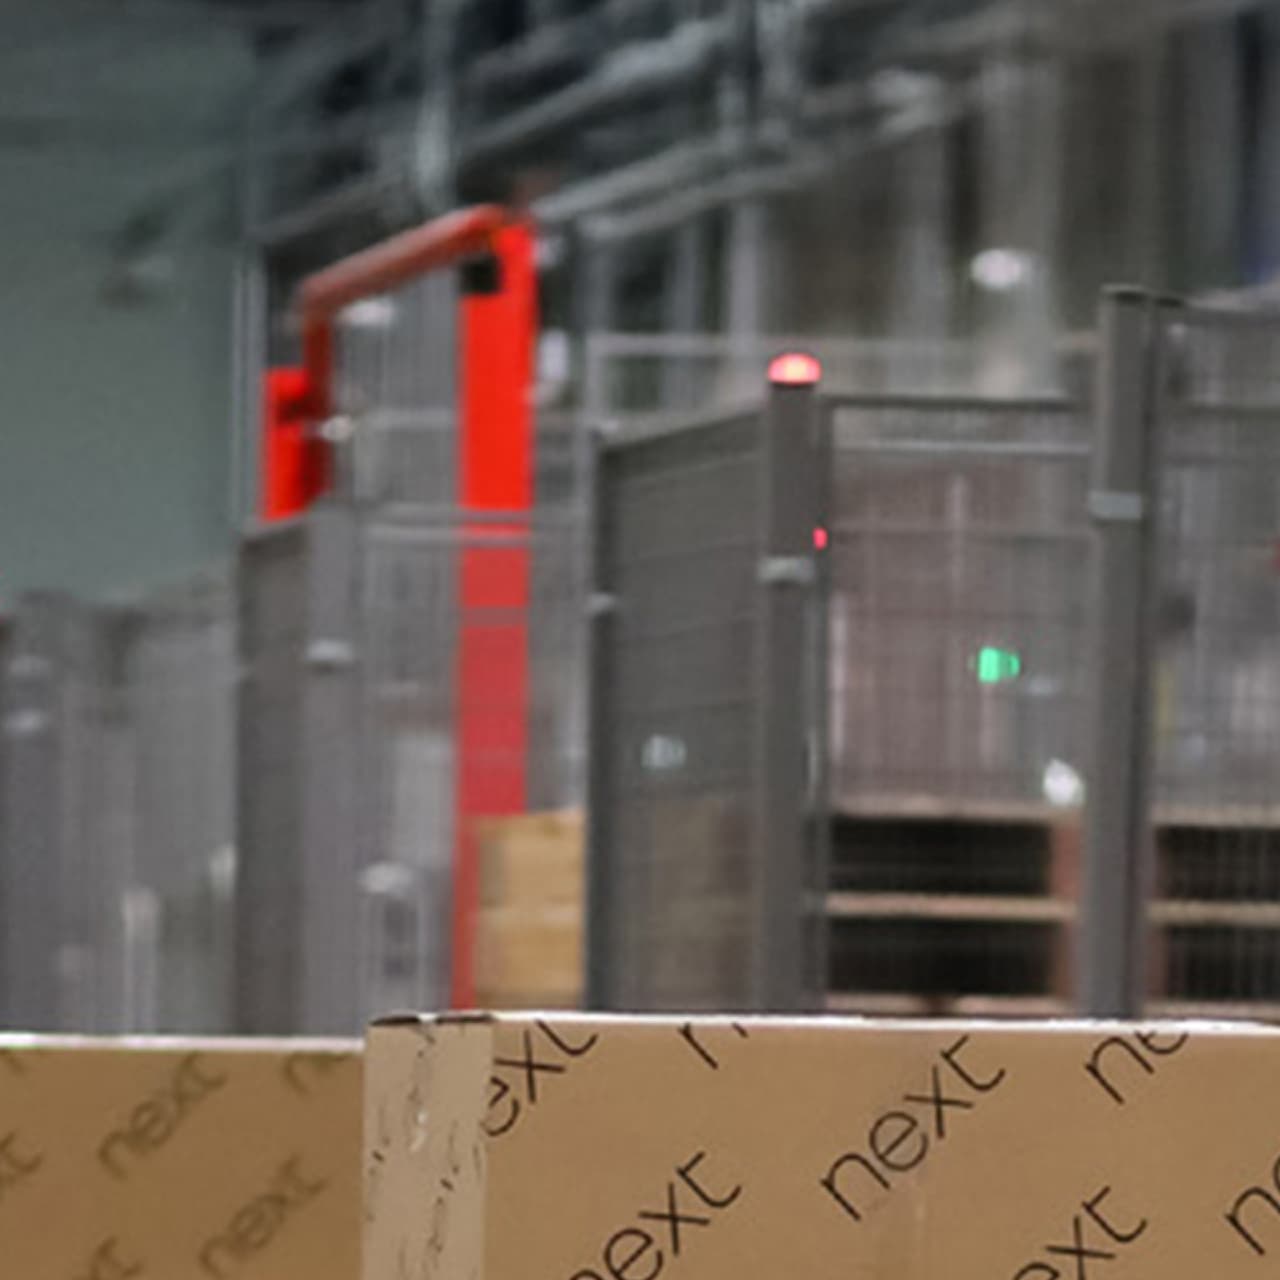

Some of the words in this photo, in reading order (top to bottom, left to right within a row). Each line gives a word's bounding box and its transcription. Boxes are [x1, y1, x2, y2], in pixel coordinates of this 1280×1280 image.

[96, 1049, 228, 1179] next
[480, 1020, 599, 1138] ext
[820, 1035, 1006, 1222] next
